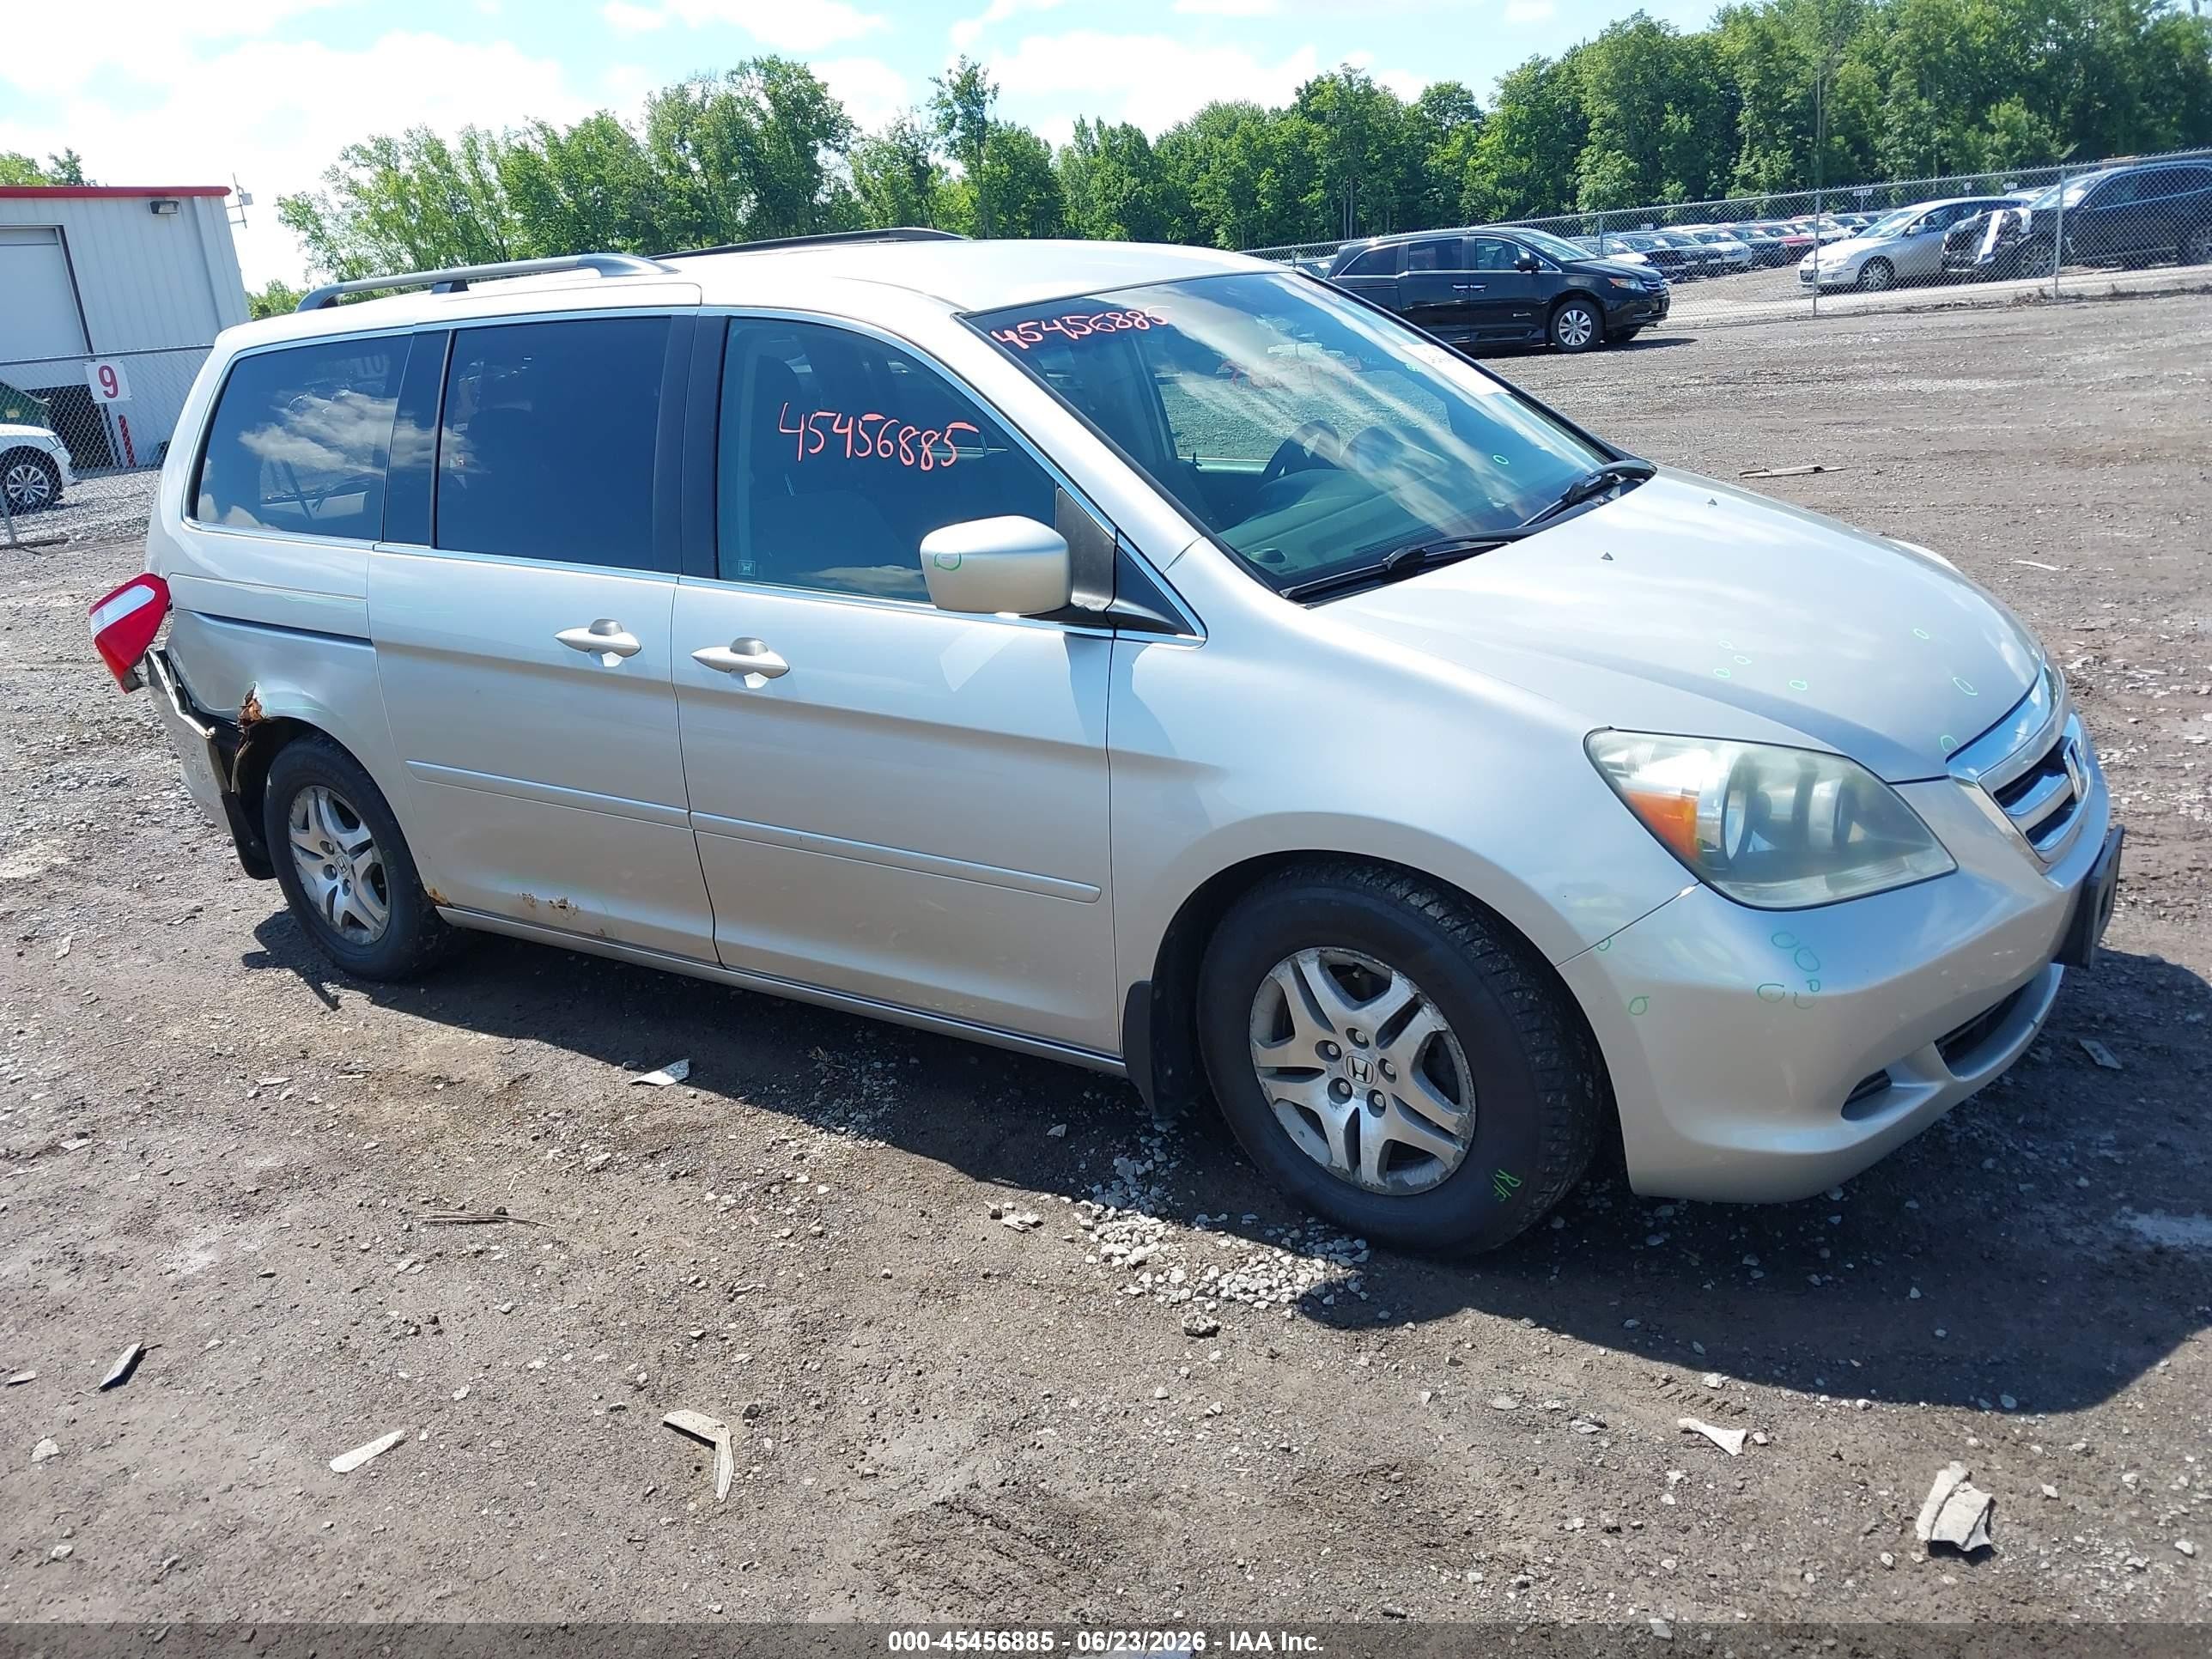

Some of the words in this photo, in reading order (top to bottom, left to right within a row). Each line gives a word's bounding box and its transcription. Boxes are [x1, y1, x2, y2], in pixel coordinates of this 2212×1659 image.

[991, 306, 1171, 349] 45456885
[98, 365, 118, 398] 9
[779, 402, 980, 471] 45456885
